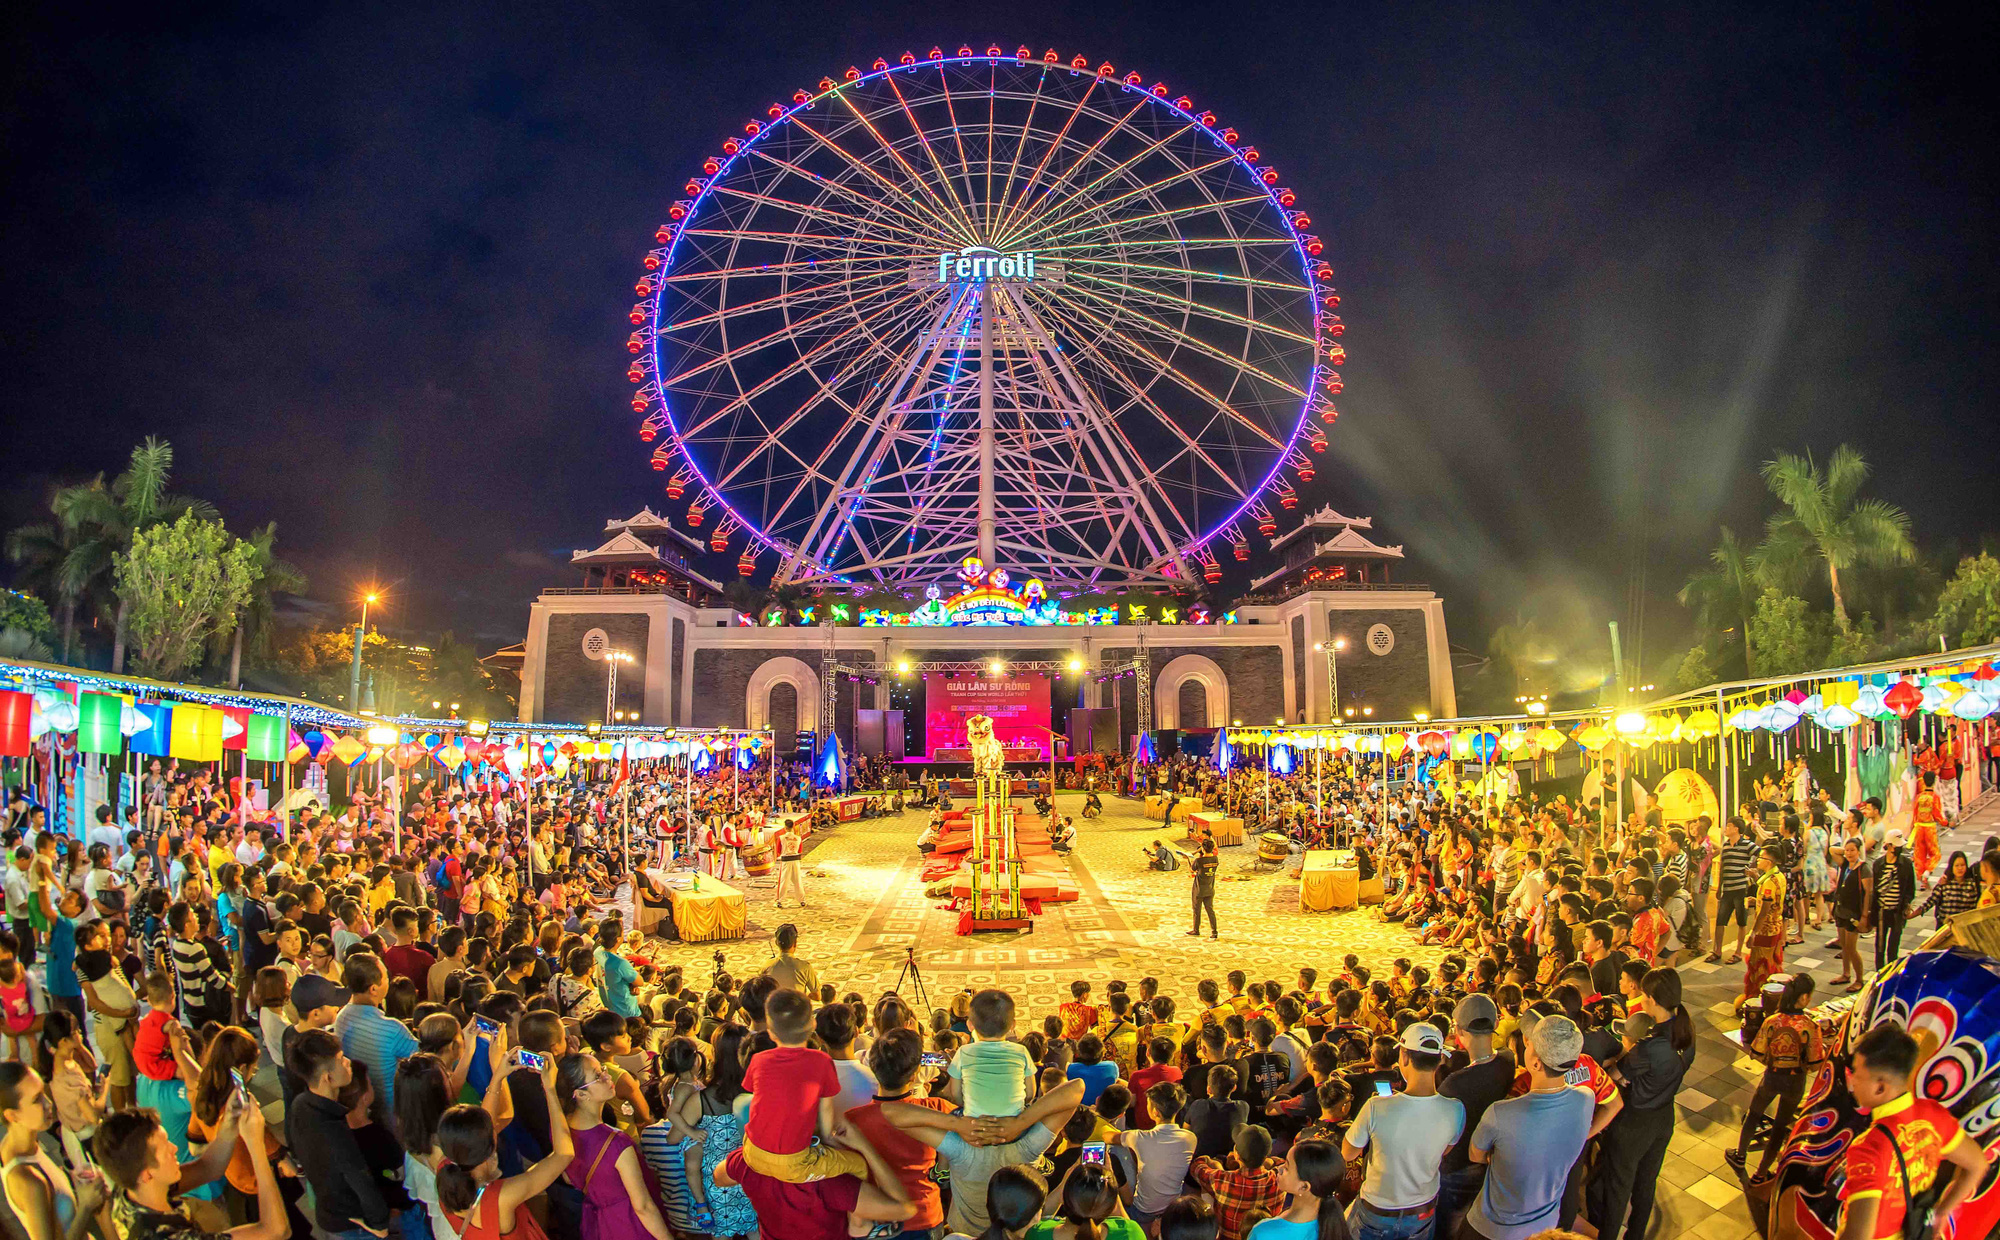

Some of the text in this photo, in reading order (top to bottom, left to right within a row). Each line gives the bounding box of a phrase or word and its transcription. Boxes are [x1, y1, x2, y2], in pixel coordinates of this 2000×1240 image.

[939, 249, 1034, 282] Ferroli
[946, 681, 966, 691] GIẢI
[968, 681, 987, 691] LÂN
